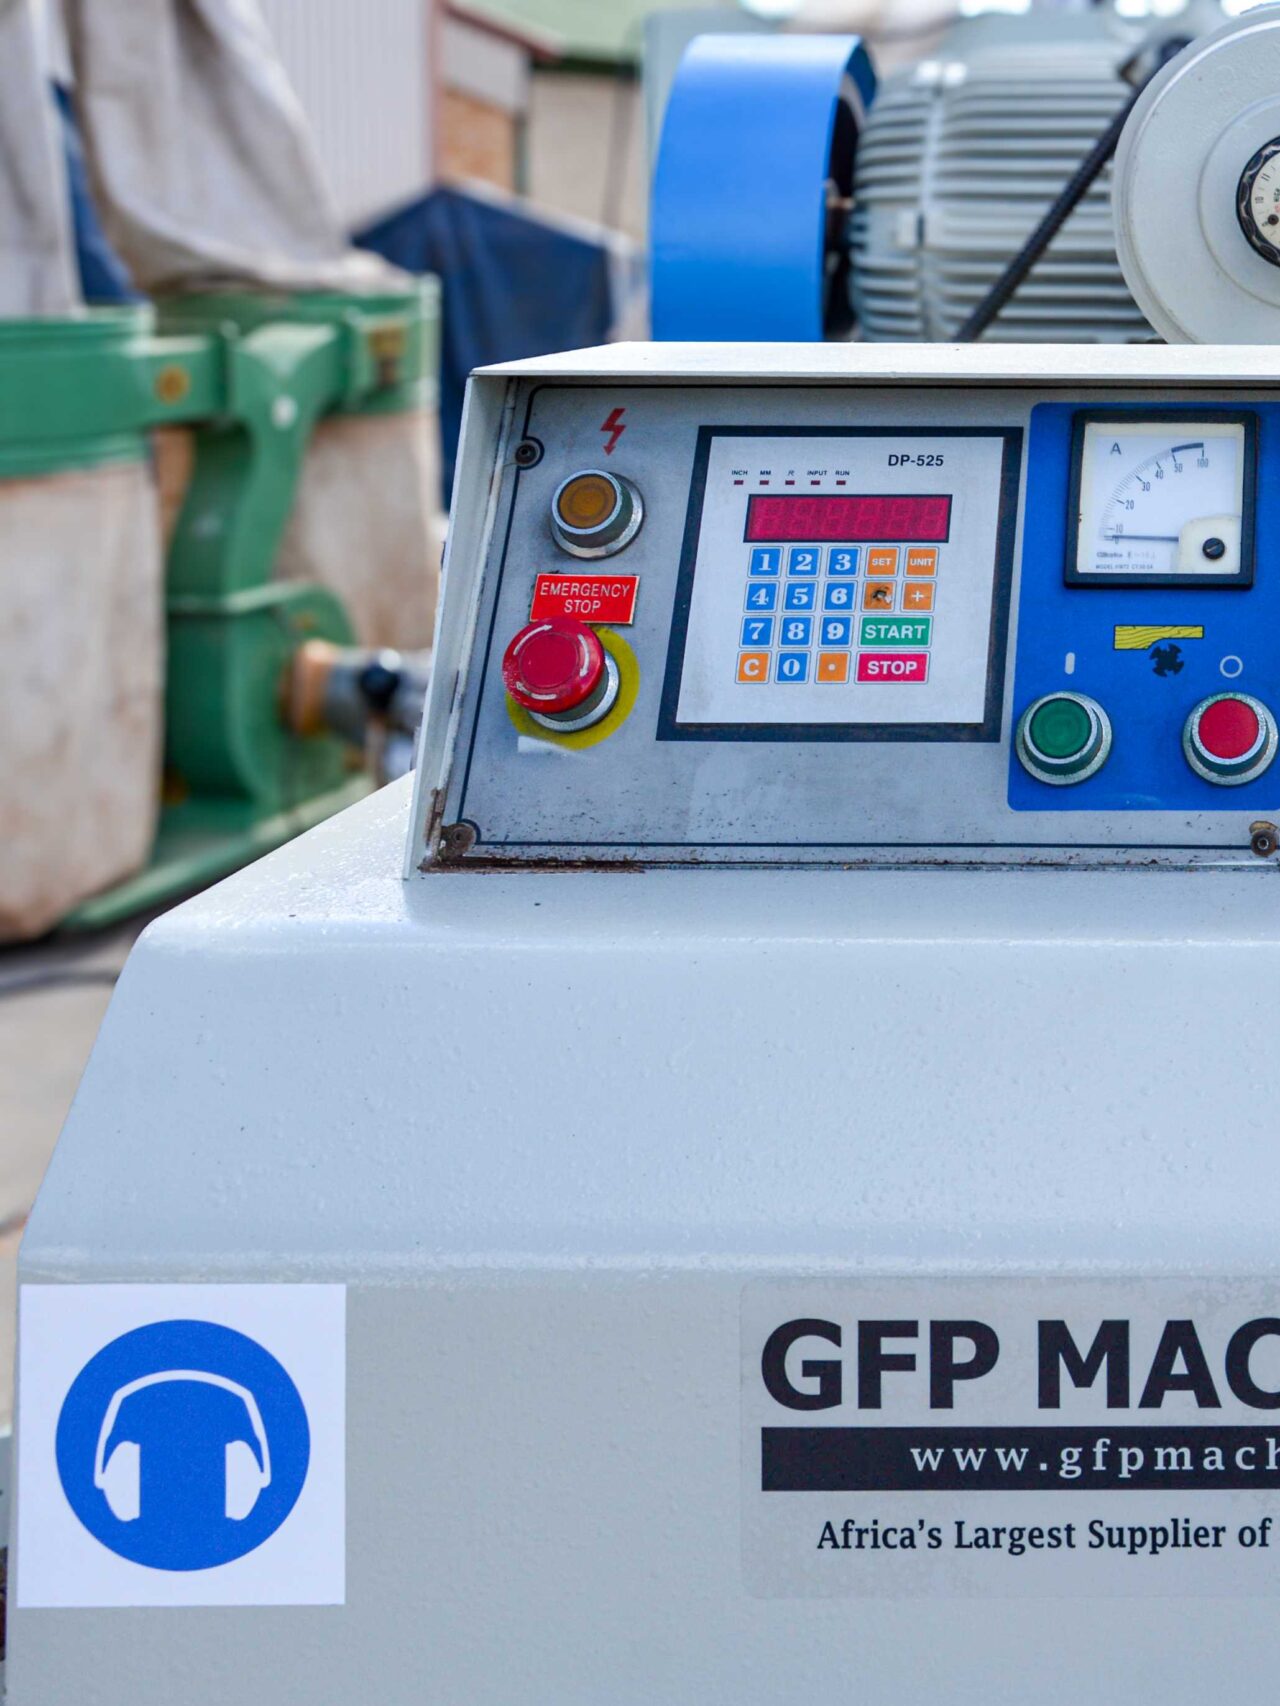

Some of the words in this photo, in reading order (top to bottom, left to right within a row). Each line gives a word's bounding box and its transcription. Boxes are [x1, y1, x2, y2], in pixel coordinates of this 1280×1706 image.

[1110, 442, 1122, 455] A
[887, 454, 945, 467] DP-525
[1174, 462, 1183, 473] 50
[1155, 469, 1164, 480] 40
[1141, 481, 1151, 492] 30
[1125, 499, 1135, 510] 20
[759, 553, 773, 571] 1
[795, 553, 813, 571] 2
[835, 553, 851, 571] 3
[871, 557, 892, 566] SET
[909, 557, 933, 566] UNIT
[540, 582, 630, 598] EMERGENCY
[751, 588, 769, 605] 4
[792, 588, 809, 605] 5
[831, 588, 848, 605] 6
[564, 599, 601, 614] STOP
[749, 622, 765, 640] 7
[788, 622, 805, 640] 8
[827, 622, 845, 640] 9
[864, 624, 927, 640] START
[743, 659, 760, 676] C
[782, 658, 801, 677] 0
[867, 660, 918, 675] STOP
[760, 1317, 1001, 1412] GFP
[816, 1518, 943, 1551] Africa's
[954, 1519, 1077, 1557] Largest
[1088, 1517, 1228, 1555] Supplier
[1238, 1517, 1273, 1549] of
